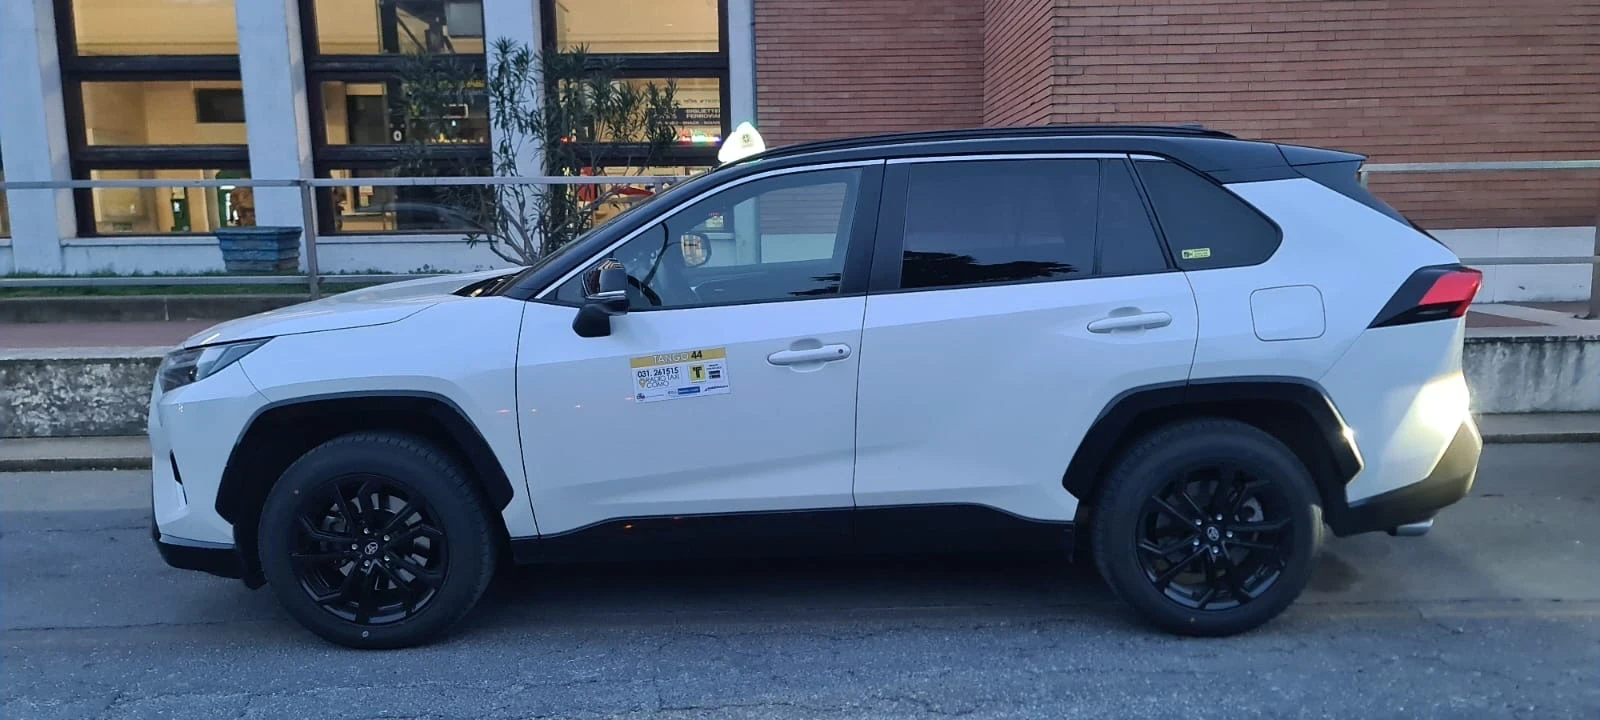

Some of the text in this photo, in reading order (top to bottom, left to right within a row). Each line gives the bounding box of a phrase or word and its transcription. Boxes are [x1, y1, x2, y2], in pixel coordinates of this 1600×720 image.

[653, 350, 702, 364] TANGO 44
[654, 367, 679, 376] 261515
[647, 380, 670, 388] COMO
